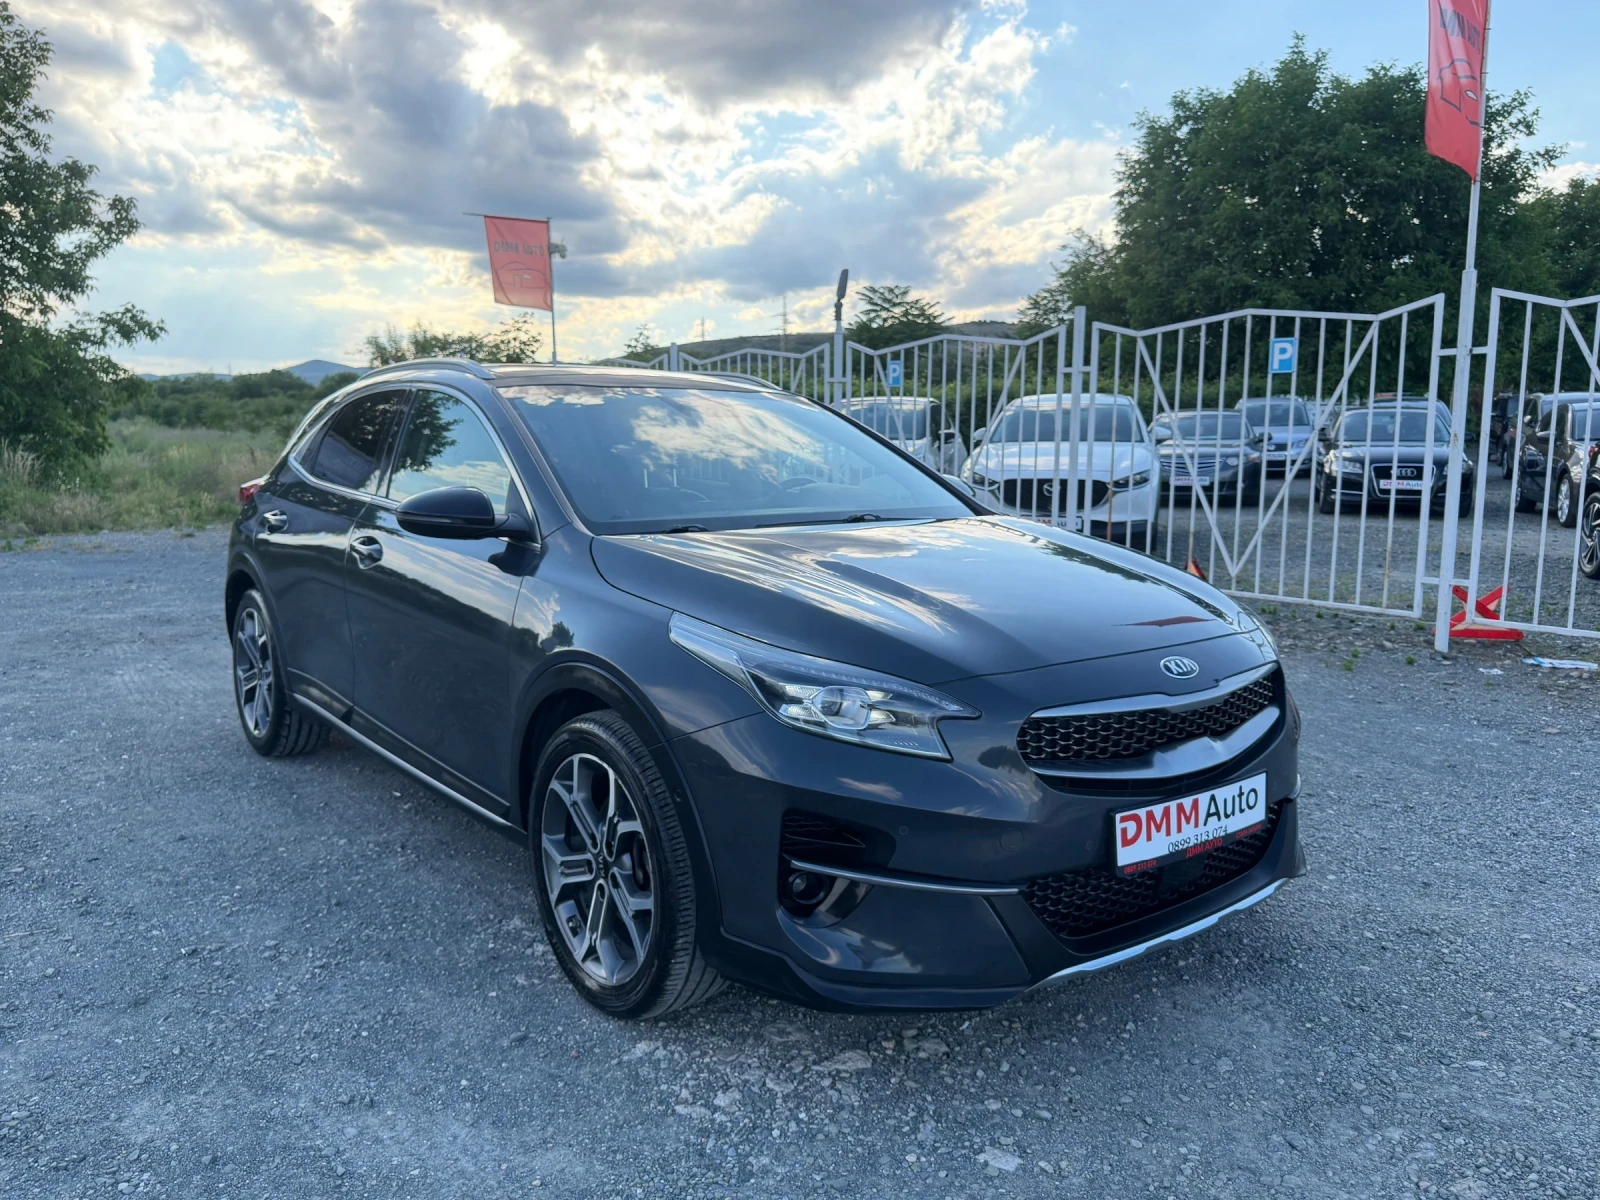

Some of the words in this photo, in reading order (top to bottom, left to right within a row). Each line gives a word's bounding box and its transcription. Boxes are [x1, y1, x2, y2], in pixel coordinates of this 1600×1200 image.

[1273, 342, 1293, 370] P
[889, 364, 900, 385] P
[1163, 659, 1197, 674] KIA
[1168, 836, 1191, 853] 0899
[1193, 830, 1210, 845] 313
[1212, 824, 1228, 839] 074
